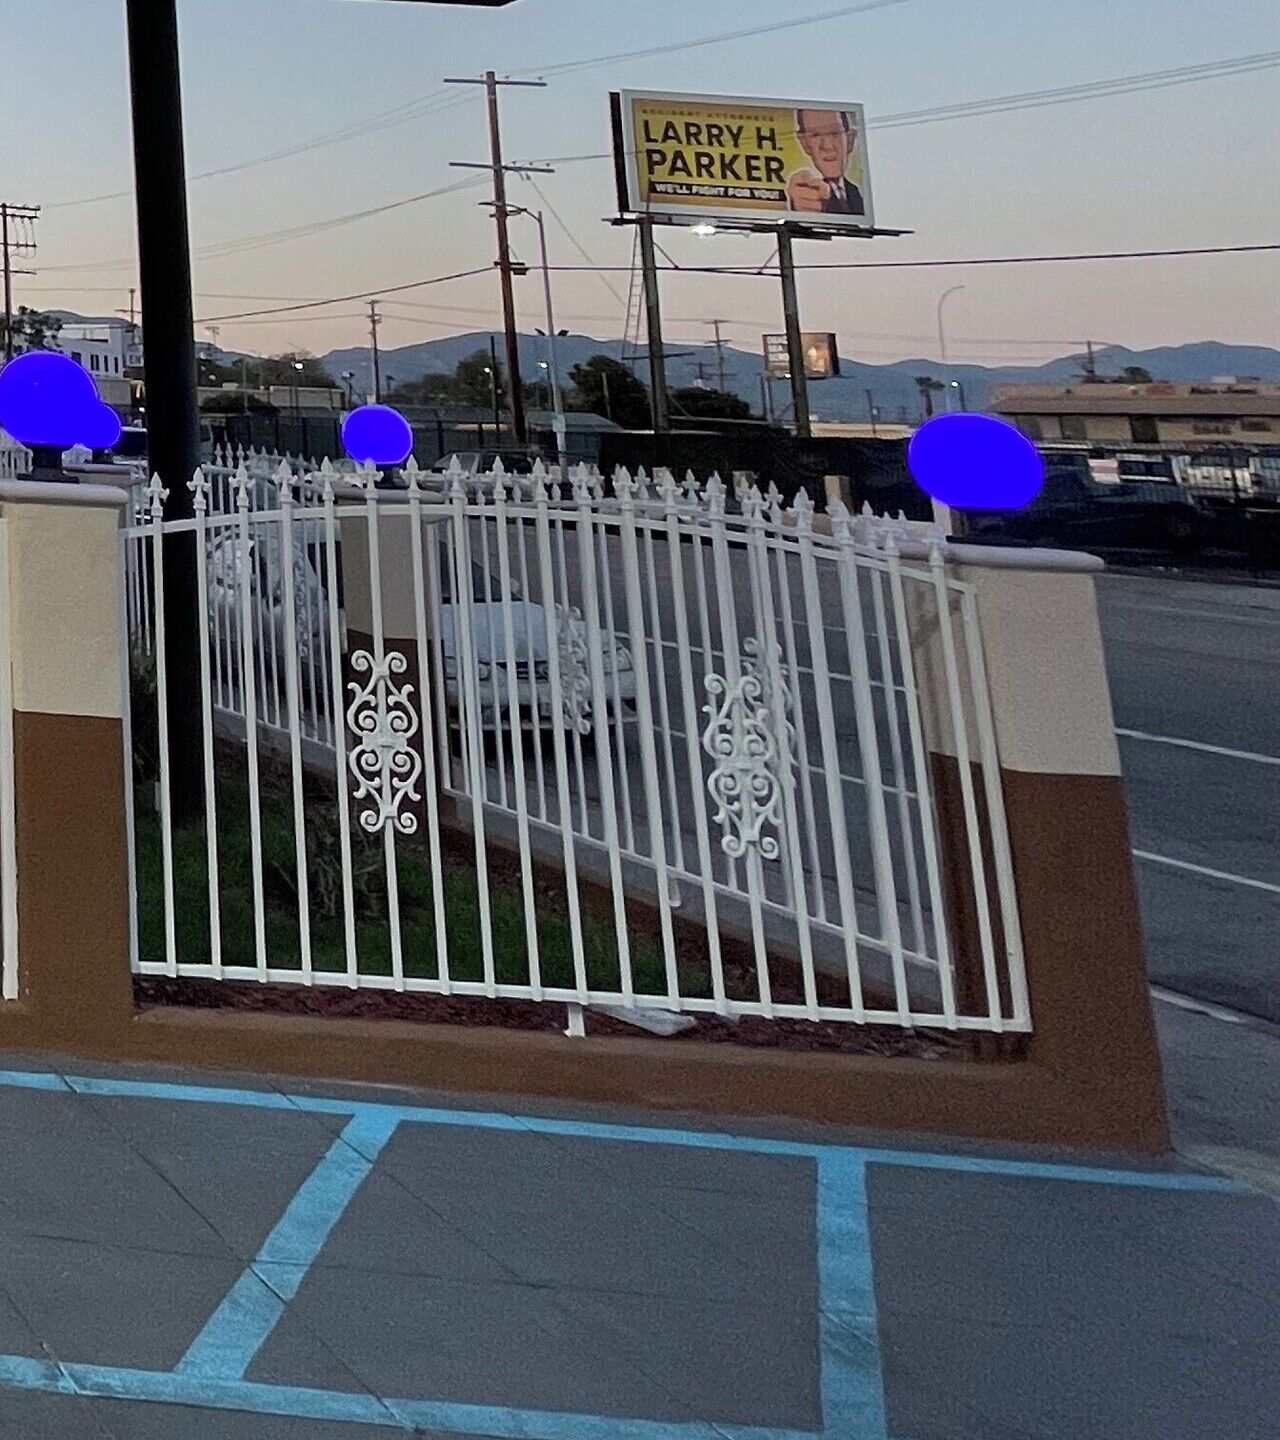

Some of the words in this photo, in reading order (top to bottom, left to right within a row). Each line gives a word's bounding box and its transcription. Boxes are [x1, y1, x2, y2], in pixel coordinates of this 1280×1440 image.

[643, 120, 744, 148] LARRY
[756, 127, 783, 151] H.
[646, 149, 786, 183] PARKER
